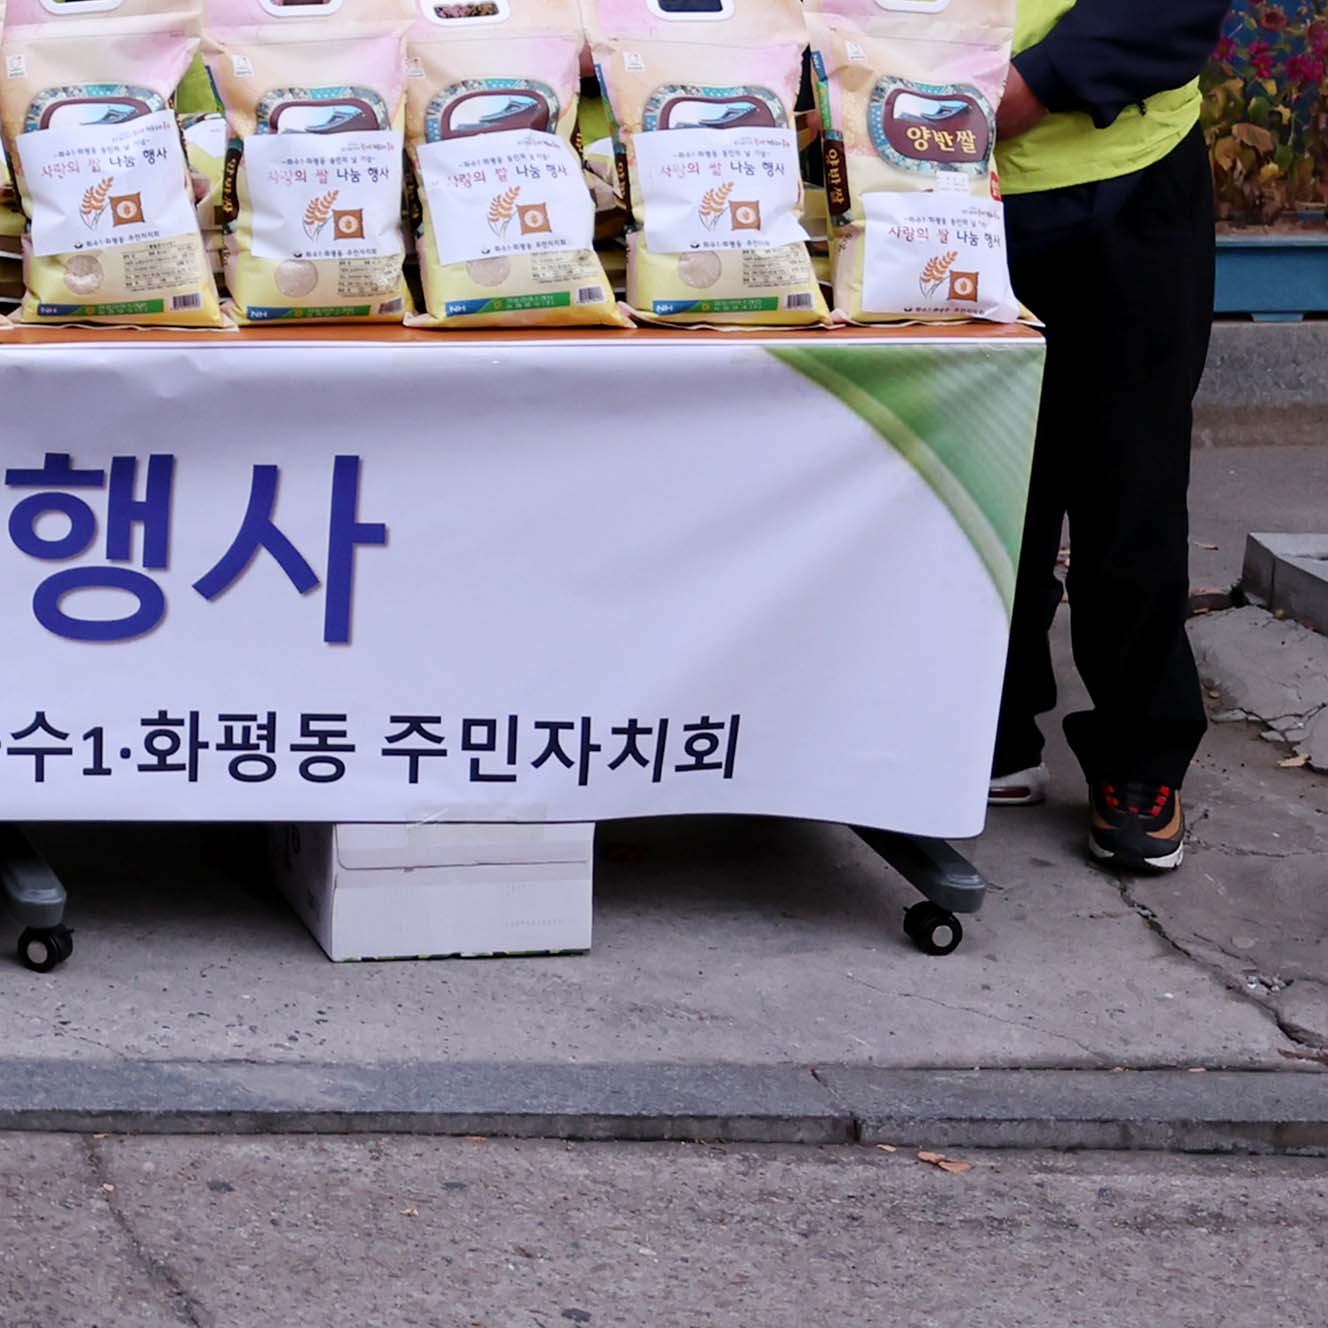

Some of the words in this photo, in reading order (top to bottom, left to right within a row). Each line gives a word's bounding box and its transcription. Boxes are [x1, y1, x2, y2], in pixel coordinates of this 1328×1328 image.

[907, 126, 977, 154] 양반쌀
[109, 156, 136, 168] 나눔
[142, 147, 168, 165] 행사
[337, 169, 361, 183] 나눔
[368, 168, 389, 183] 행사
[516, 164, 541, 179] 나눔
[730, 161, 756, 175] 나눔
[762, 161, 784, 177] 행사
[957, 230, 979, 247] 나눔
[5, 453, 388, 646] 행사
[382, 712, 742, 787] 주민자치회
